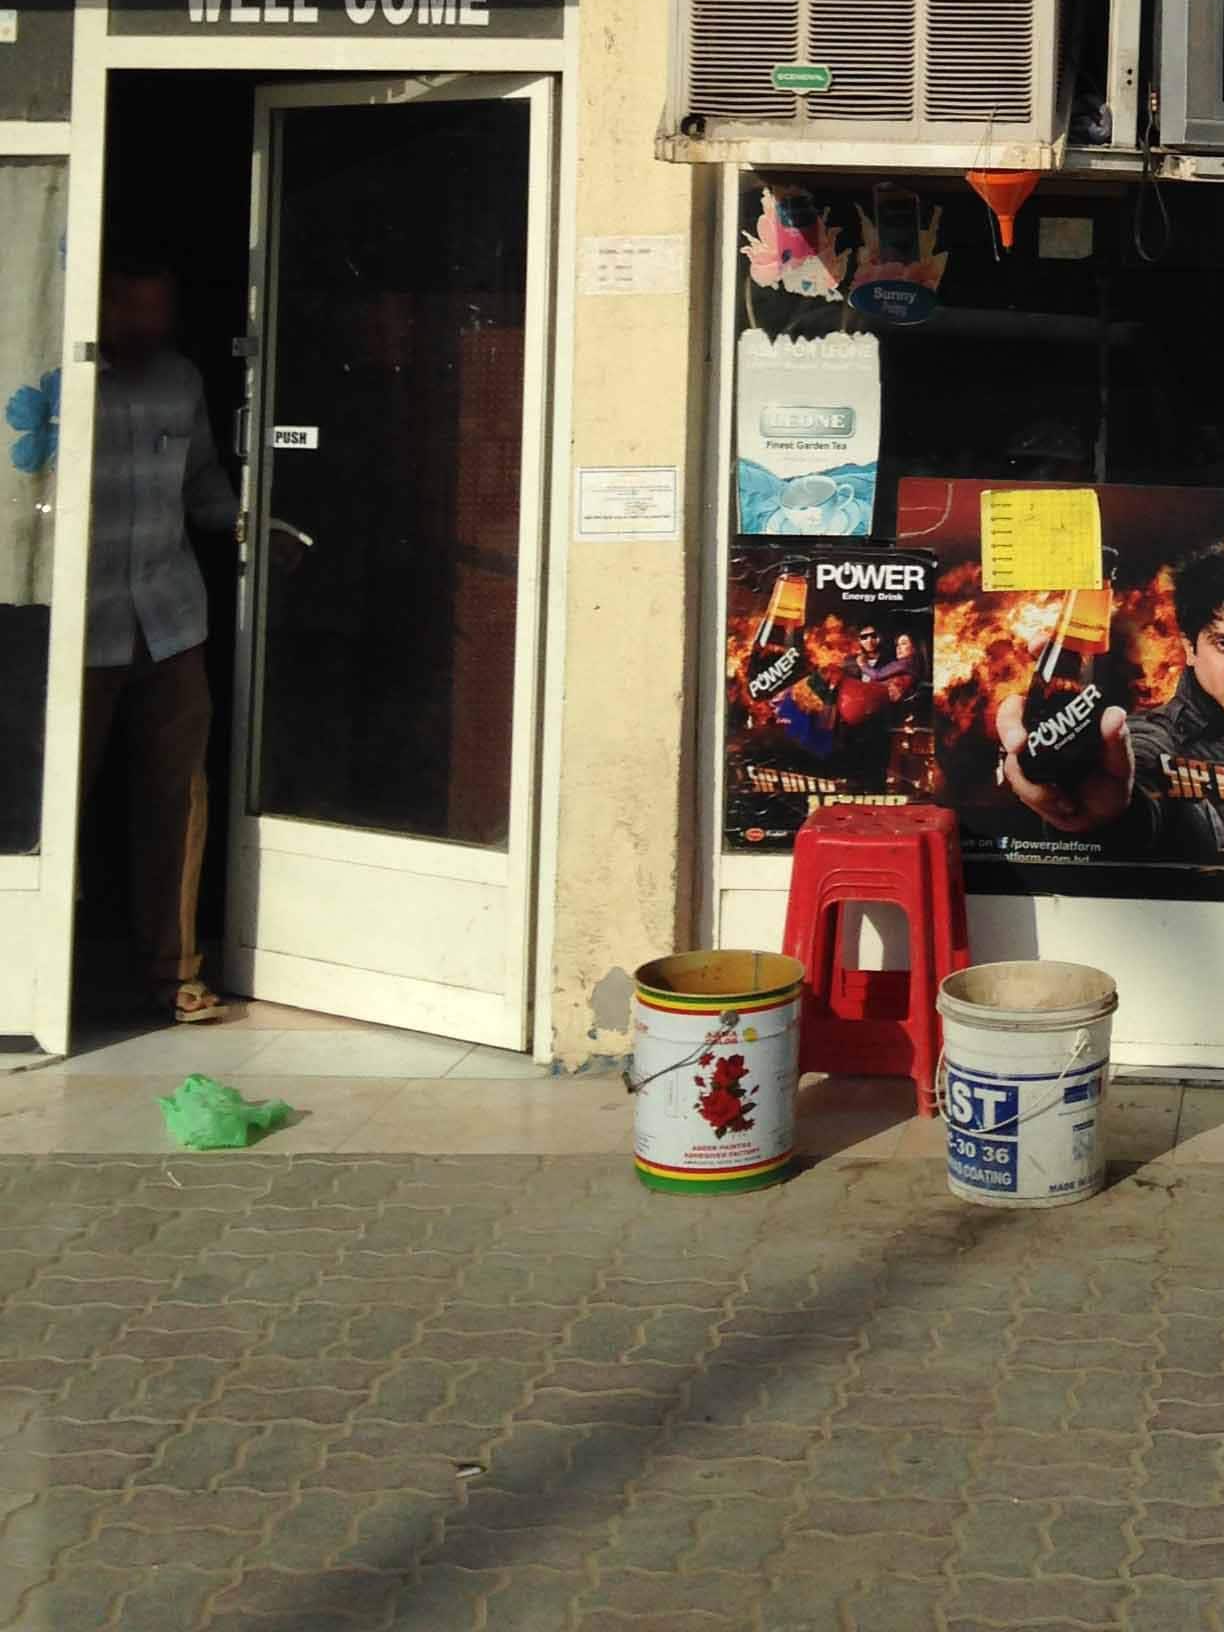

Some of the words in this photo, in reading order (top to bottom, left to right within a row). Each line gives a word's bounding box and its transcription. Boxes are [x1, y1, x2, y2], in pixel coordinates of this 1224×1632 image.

[275, 431, 307, 445] PUSH
[796, 440, 830, 450] Garden
[832, 440, 848, 450] Tea
[816, 561, 926, 591] POWER
[841, 591, 877, 603] Energy
[878, 592, 904, 601] Drink
[748, 646, 801, 699] POWER
[1027, 683, 1103, 758] POWER
[1160, 752, 1212, 800] SIP
[946, 1079, 1008, 1132] ST
[982, 1145, 1010, 1165] 36
[963, 1164, 1013, 1186] COATING
